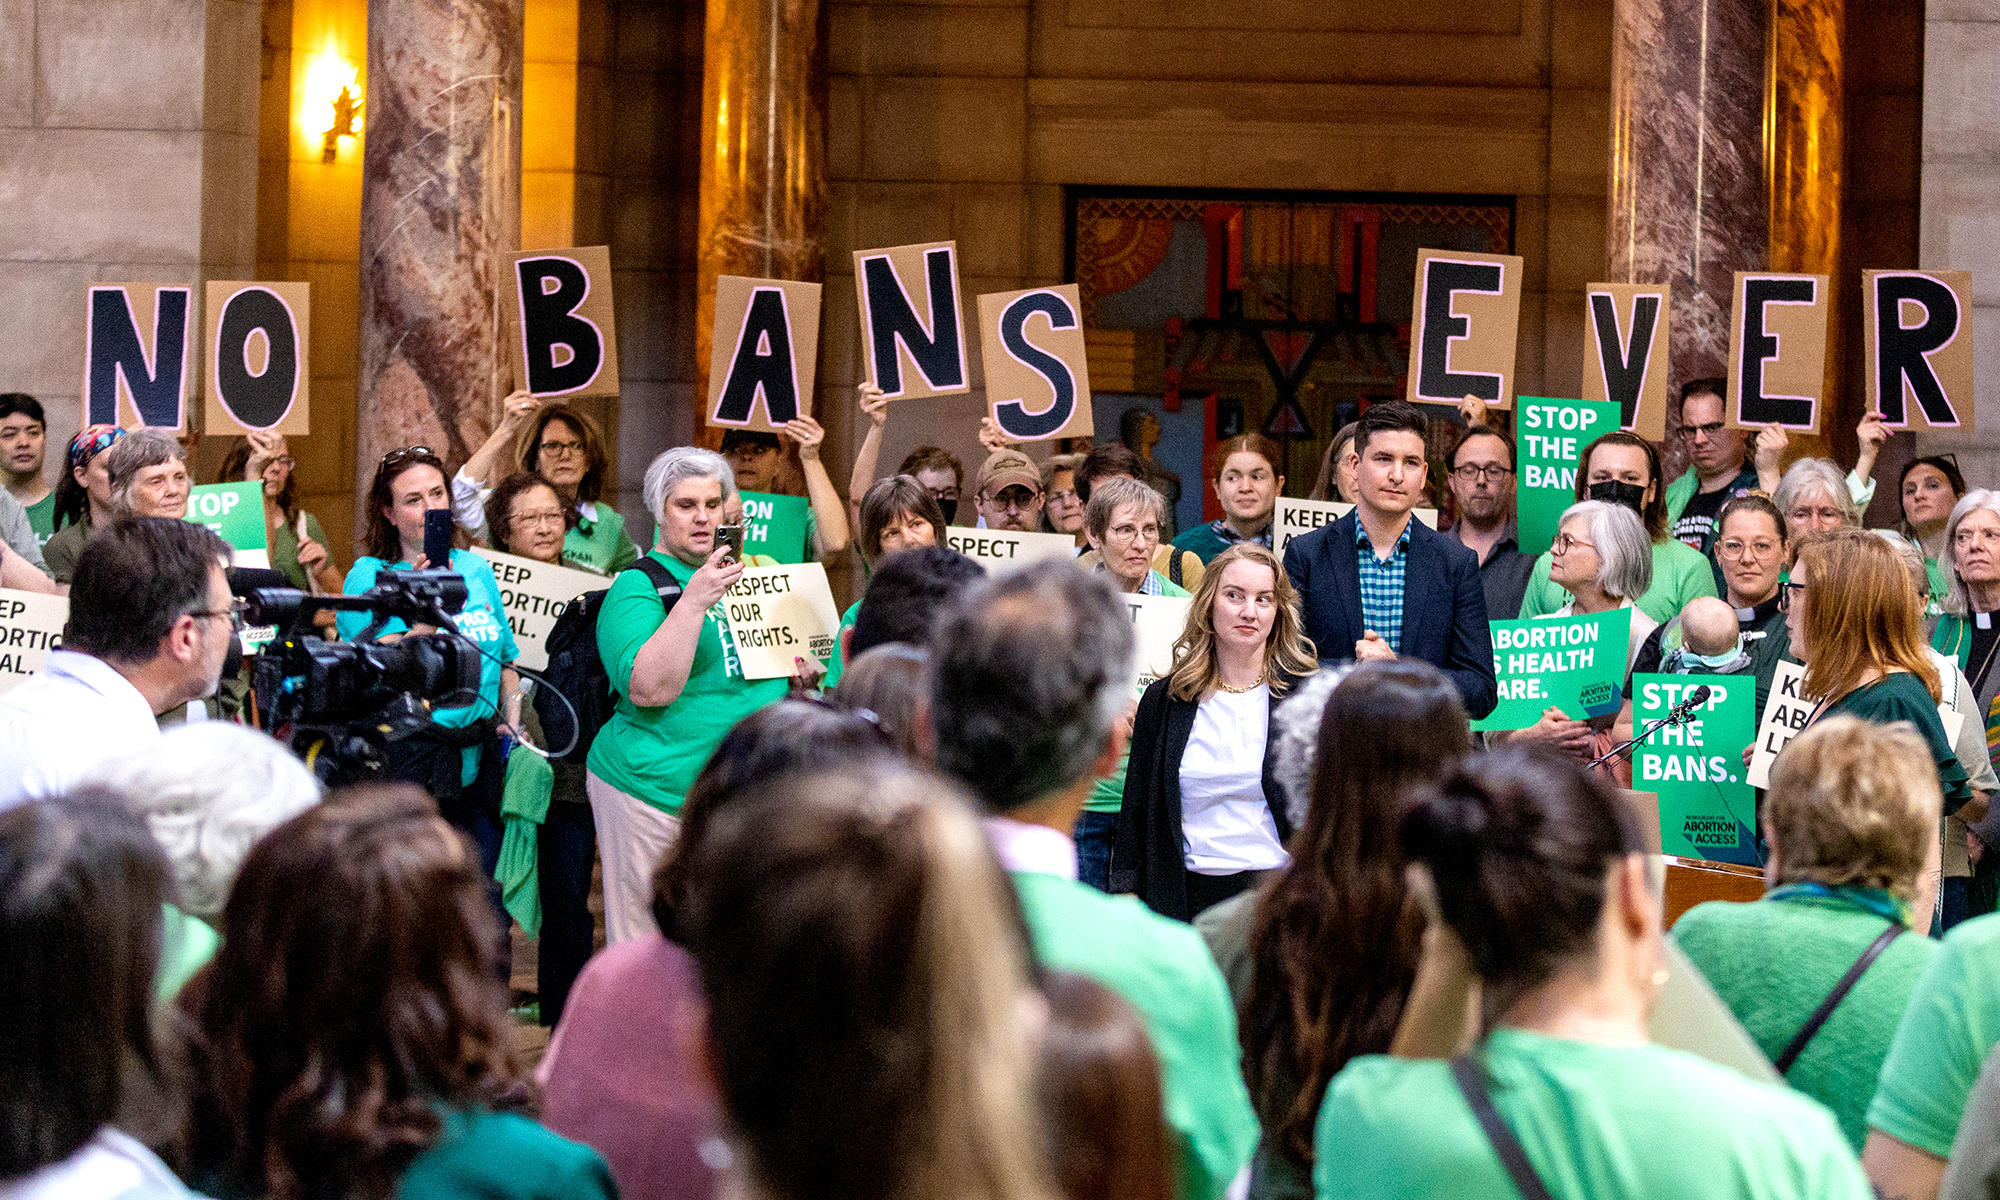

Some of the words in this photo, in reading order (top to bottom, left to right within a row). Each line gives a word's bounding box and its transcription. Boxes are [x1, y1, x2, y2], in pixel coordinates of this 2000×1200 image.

[1525, 404, 1597, 431] STOP
[1524, 434, 1577, 460] THE
[1525, 464, 1578, 490] BAN
[187, 491, 239, 518] TOP
[948, 536, 1019, 558] SPECT
[490, 561, 531, 584] EEP
[501, 589, 566, 618] ORTIO
[731, 603, 763, 622] OUR
[737, 626, 799, 648] RIGHTS.
[1491, 622, 1599, 650] BORTION
[1508, 647, 1595, 674] HEALTH
[1497, 678, 1548, 700] ARE.
[1642, 754, 1738, 783] BANS.
[1684, 821, 1736, 832] ABORTION
[1695, 833, 1736, 844] ACCESS
